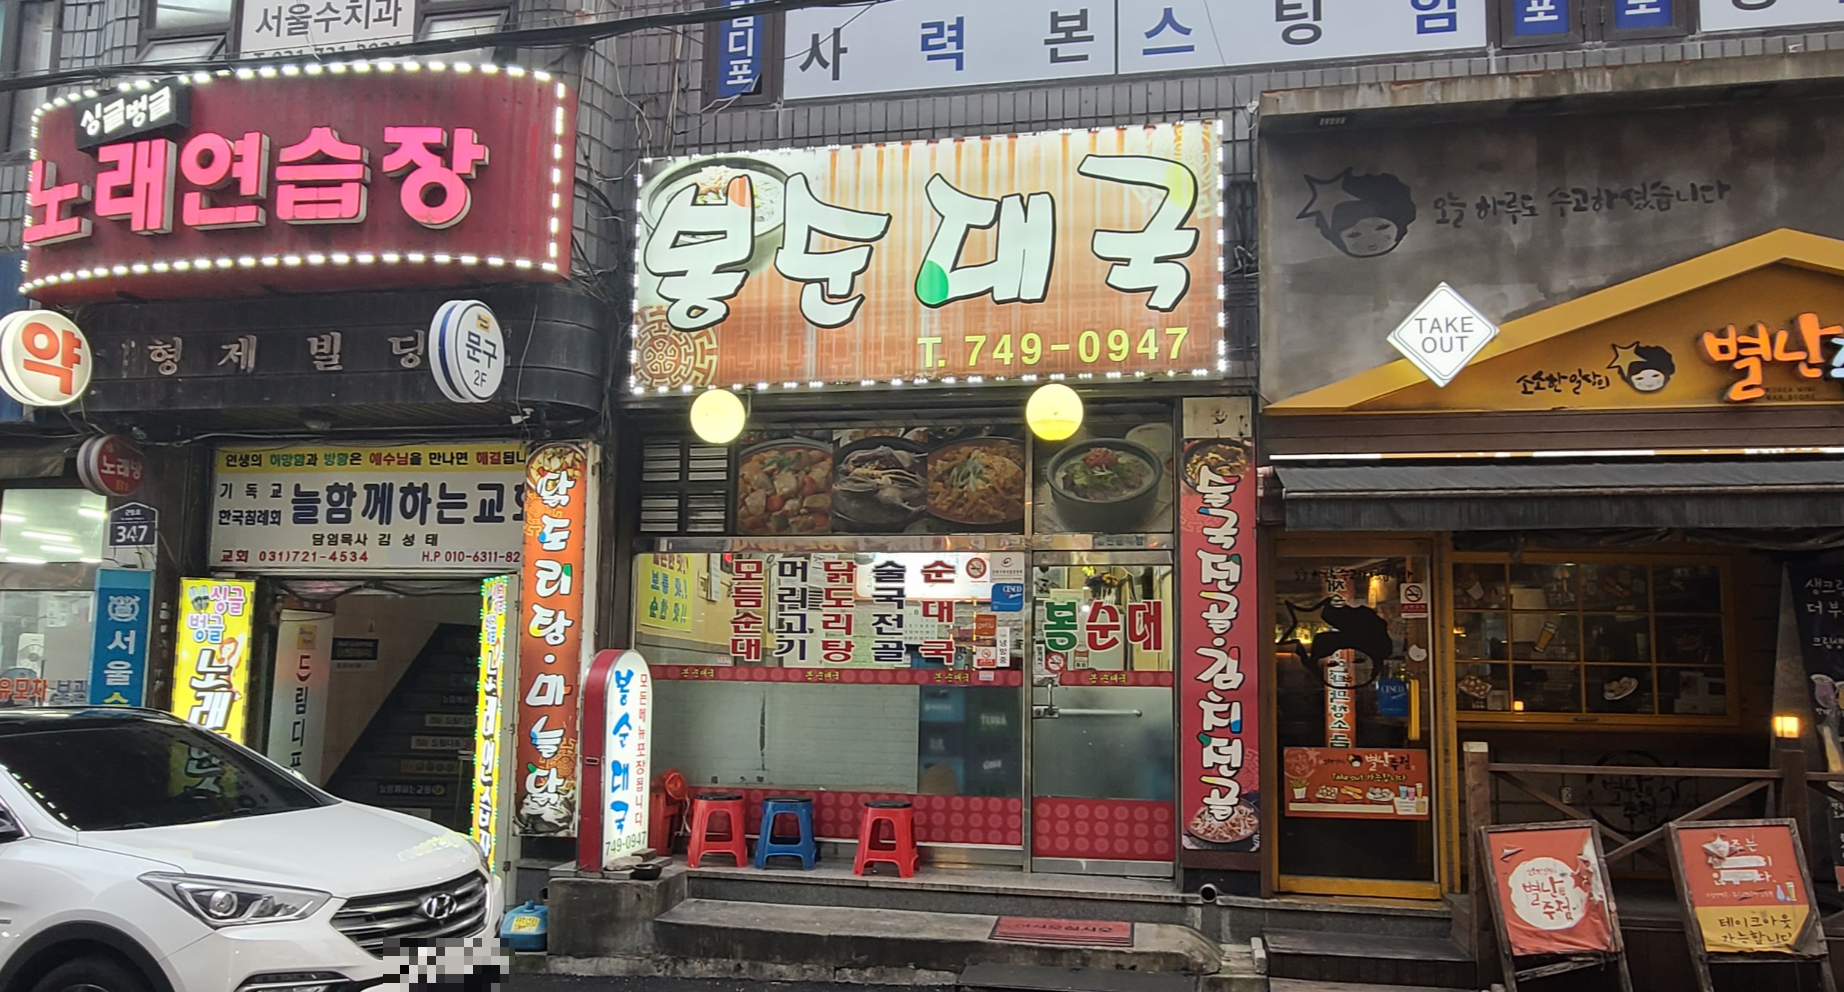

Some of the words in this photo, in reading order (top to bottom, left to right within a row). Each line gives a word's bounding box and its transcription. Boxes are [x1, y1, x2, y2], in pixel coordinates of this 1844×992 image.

[255, 0, 402, 37] 서울수치과
[80, 84, 173, 136] 싱글벙글
[22, 125, 489, 247] 노래연습장
[1433, 192, 1467, 228] 오늘
[1475, 191, 1539, 224] 하루도
[1547, 180, 1731, 218] 수고하셨습니다
[643, 153, 1200, 332] 봉순대국
[1414, 316, 1474, 334] TAKE
[22, 322, 83, 395] 약
[465, 330, 497, 369] 문구
[917, 336, 945, 368] T.
[966, 326, 1189, 367] 749-0947
[1421, 335, 1469, 354] OUT
[473, 369, 487, 387] 2F
[1516, 370, 1568, 395] 소소한
[1569, 368, 1610, 395] 일상의
[101, 454, 143, 480] 노래방
[225, 454, 262, 467] 인생의
[324, 452, 362, 466] 방황은
[369, 451, 422, 466] 예수님을
[429, 451, 468, 465] 만나면
[218, 509, 281, 526] 한국침례회
[115, 525, 148, 542] 347
[312, 533, 368, 547] 담임목사
[220, 550, 249, 563] 교회
[210, 585, 246, 615] 싱글
[730, 560, 764, 660] 모듬순대
[774, 560, 808, 661] 머리고기
[821, 561, 857, 663] 닭도리탕
[871, 560, 906, 662] 술국전골
[919, 560, 956, 664] 순대국
[1827, 601, 1844, 618] 부
[188, 613, 225, 644] 벙글
[1043, 600, 1163, 651] 봉순대
[0, 678, 48, 702] 유모차
[187, 648, 235, 739] 노래
[605, 831, 646, 856] 749-0947
[1718, 914, 1792, 929] 테이크아웃
